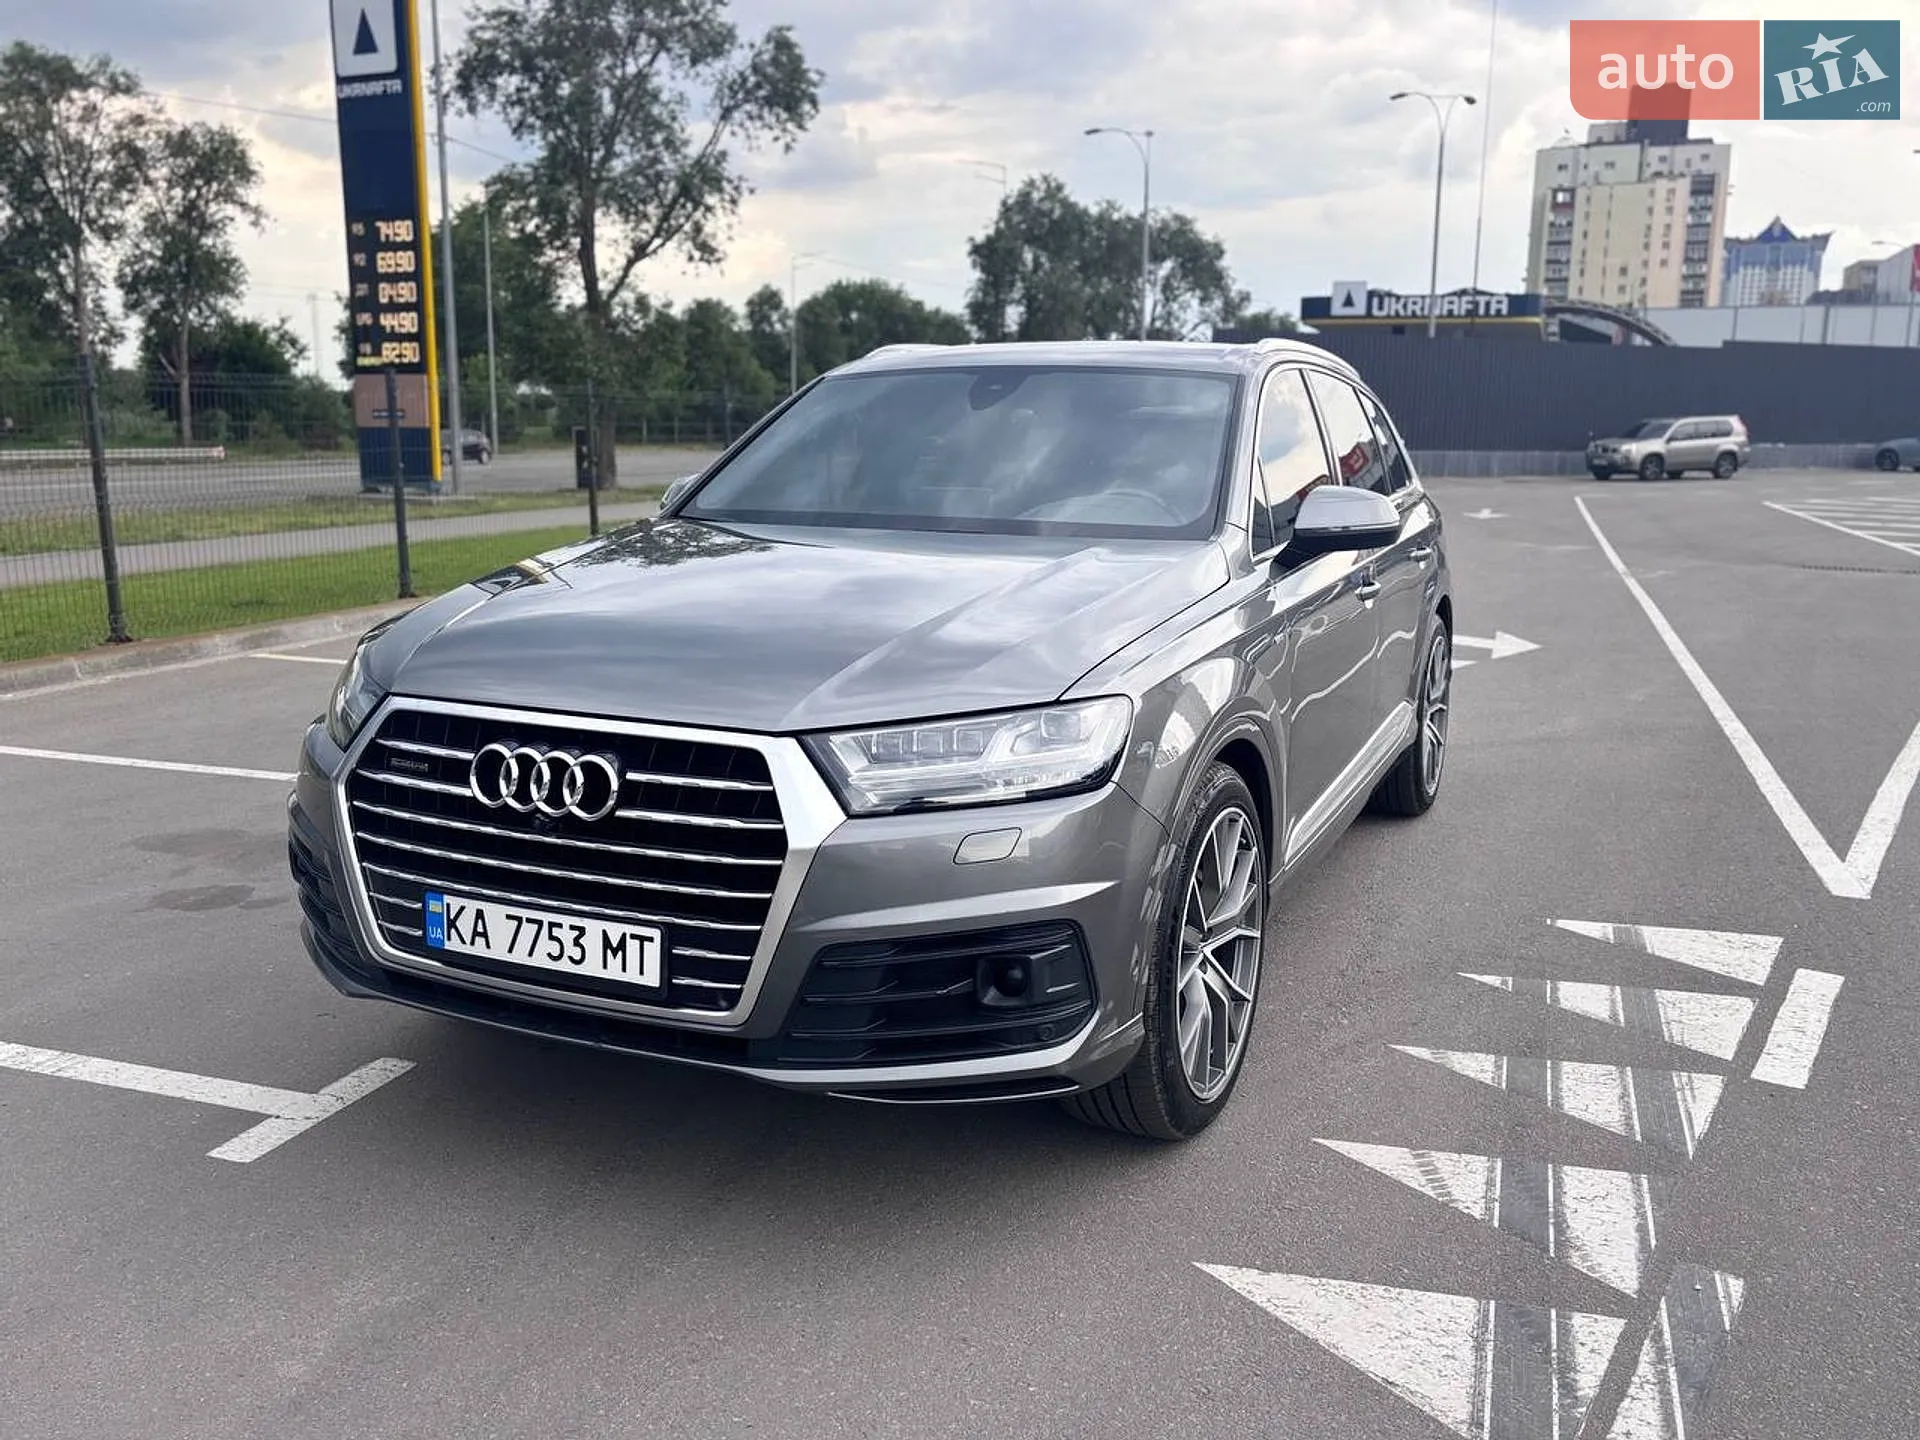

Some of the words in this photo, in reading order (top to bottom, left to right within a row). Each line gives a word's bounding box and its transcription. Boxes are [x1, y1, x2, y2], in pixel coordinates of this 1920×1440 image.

[428, 926, 443, 940] UA
[446, 902, 491, 949] KA
[505, 913, 586, 965] 7753
[602, 928, 655, 976] MT
